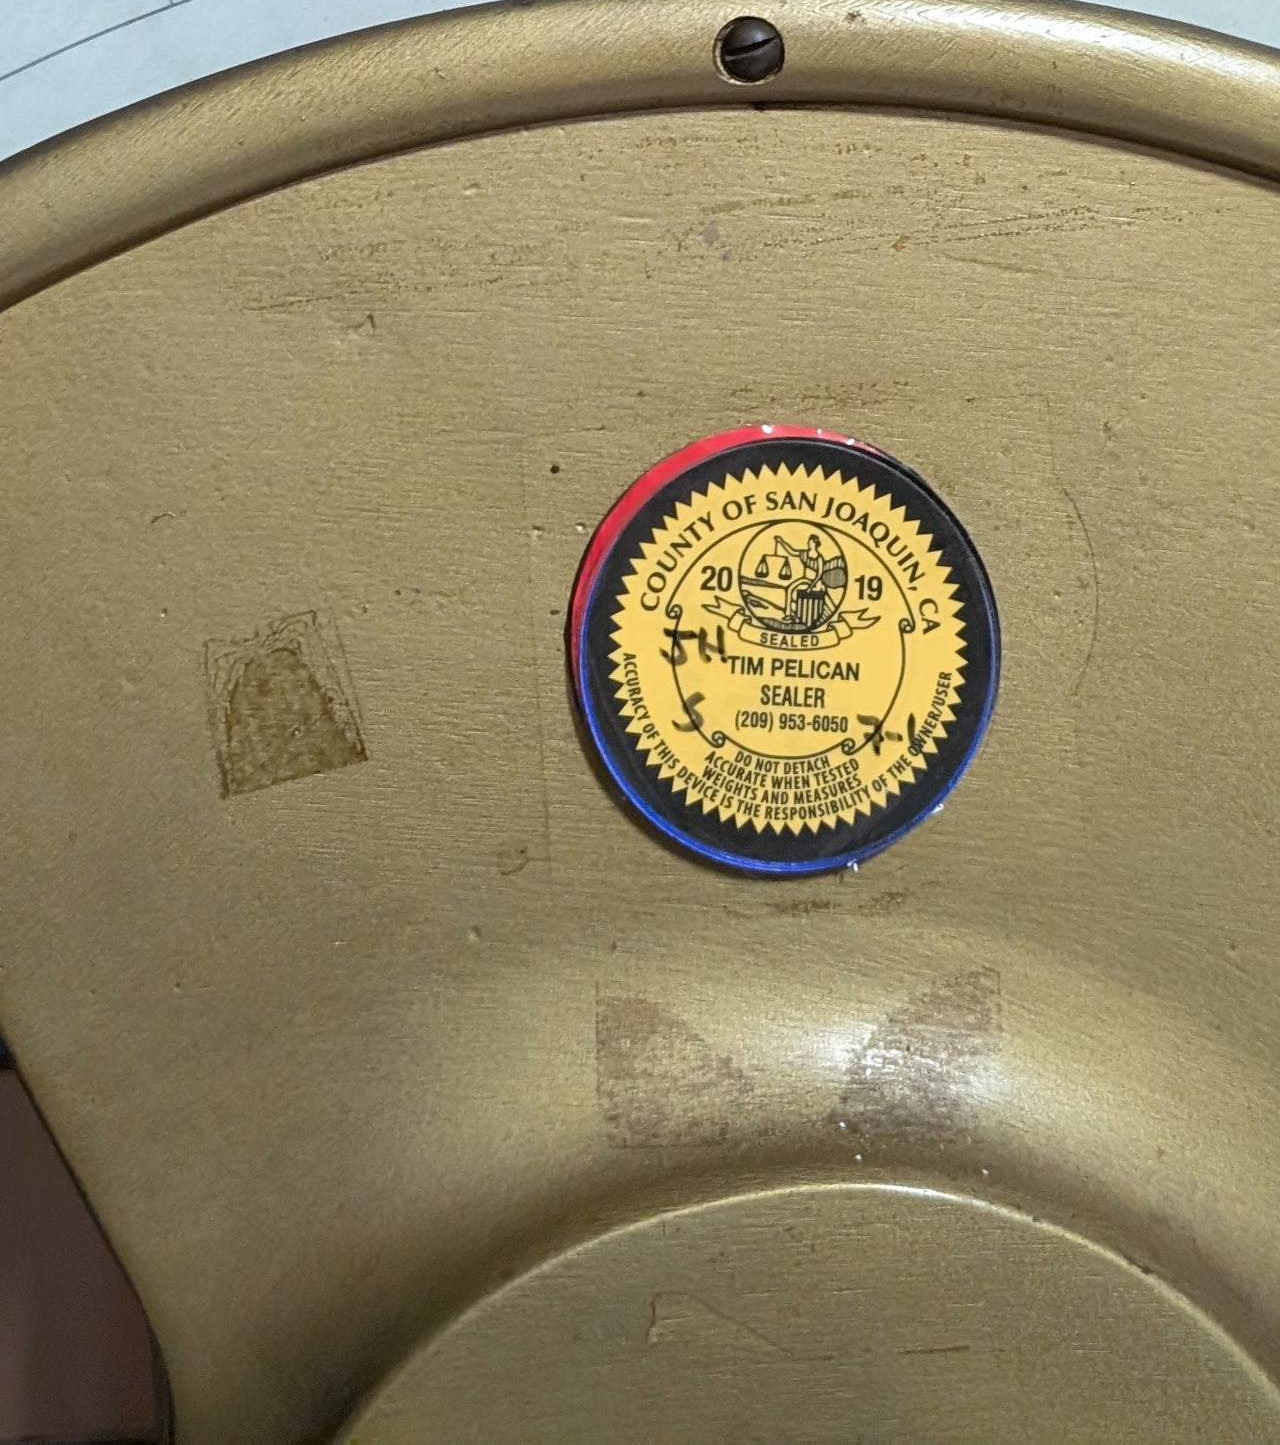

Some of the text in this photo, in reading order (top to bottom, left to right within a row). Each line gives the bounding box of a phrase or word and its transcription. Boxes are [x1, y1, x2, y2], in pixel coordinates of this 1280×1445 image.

[640, 490, 940, 635] COUNTY OF SAN JOAQUIN, CA
[701, 566, 883, 601] 20 19
[760, 632, 819, 648] SEALED
[728, 656, 860, 681] TIM PELICAN
[760, 685, 825, 709] SEALER
[623, 653, 952, 820] ACCURACY OF THIS DEVICE IS THE RESPONSIBILITY OF THE OWNER/USER
[735, 710, 849, 733] (209) 953-6050
[704, 751, 859, 789] ACCURATE WHEN TESTED
[734, 752, 830, 774] DO NOT DETACH
[702, 765, 862, 804] WEIGHTS AND MEASURES
